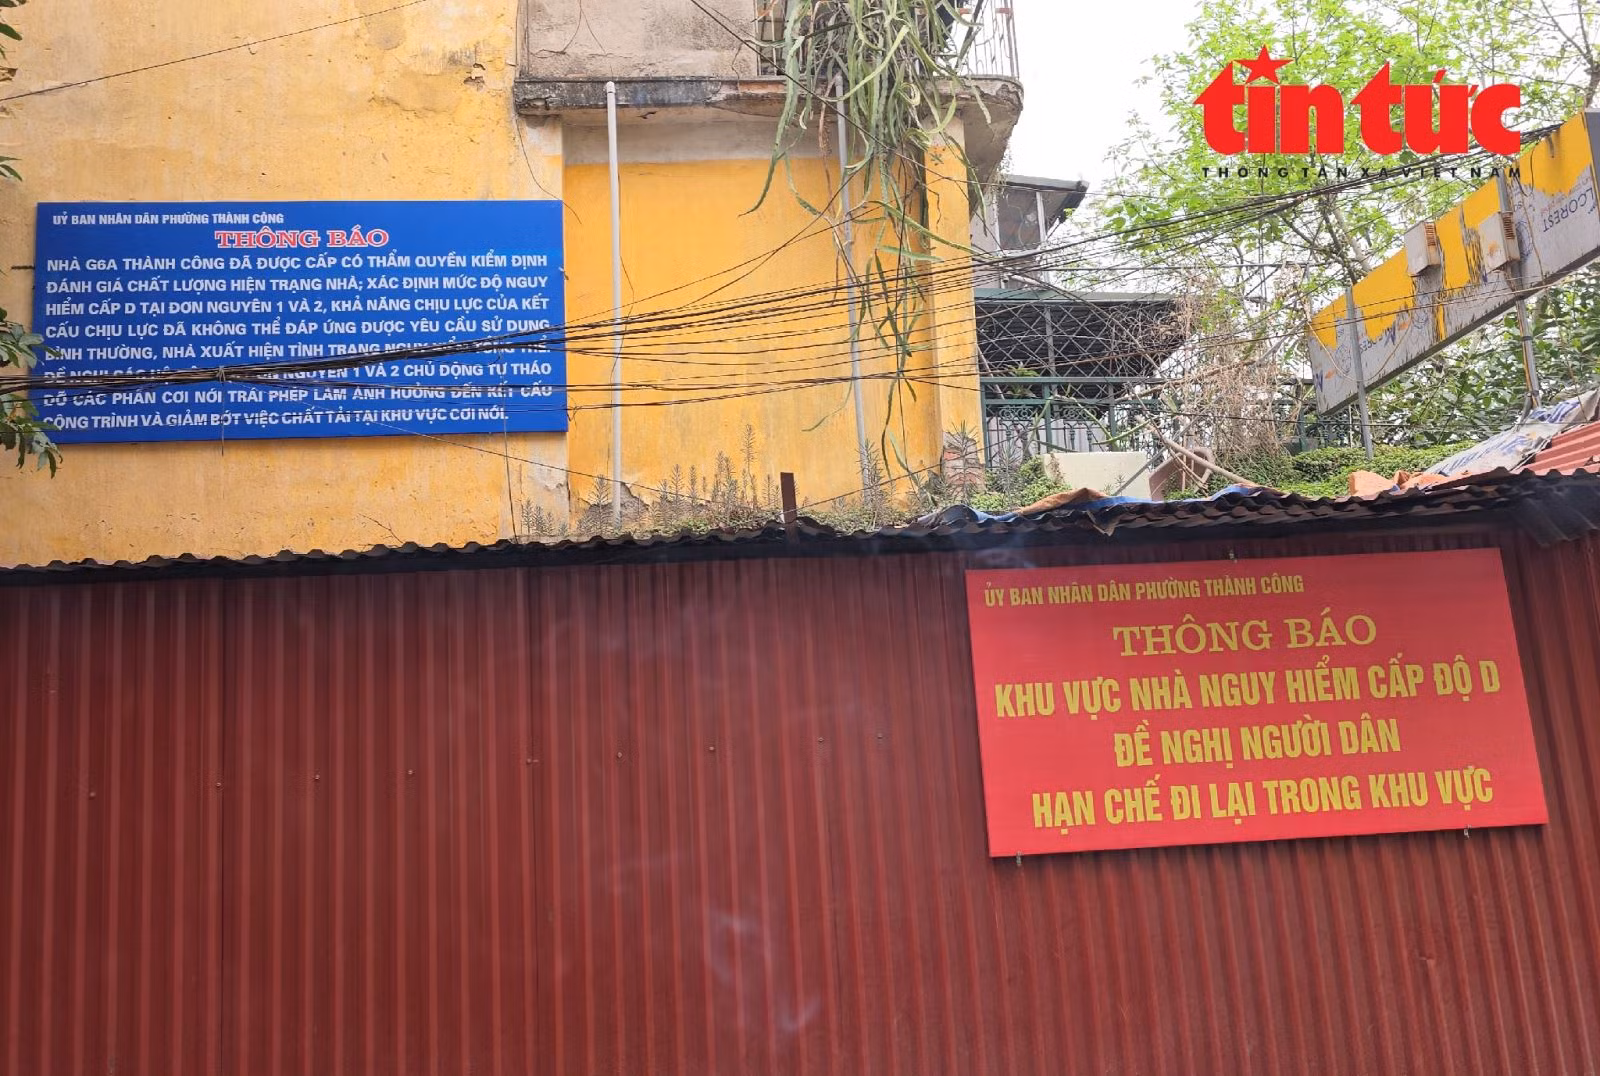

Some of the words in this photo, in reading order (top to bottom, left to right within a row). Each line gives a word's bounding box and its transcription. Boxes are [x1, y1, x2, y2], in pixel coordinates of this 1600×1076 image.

[71, 214, 96, 225] BAN
[99, 212, 132, 225] NHÂN
[134, 212, 159, 225] DÂN
[214, 225, 320, 249] THÔNG
[327, 224, 390, 248] BÁO
[47, 256, 81, 271] NHÀ
[85, 258, 118, 271] G6A
[122, 255, 176, 271] THÀNH
[180, 255, 225, 270] CÔNG
[229, 255, 252, 269] ĐÃ
[256, 256, 301, 272] ĐƯỢC
[305, 251, 337, 269] CẤP
[341, 253, 363, 268] CÓ
[367, 248, 411, 268] THẨM
[415, 250, 467, 268] QUYỀN
[471, 248, 507, 267] KIỂM
[511, 254, 547, 271] ĐỊNH
[46, 278, 92, 293] ĐÁNH
[96, 277, 124, 293] GIÁ
[127, 275, 169, 292] CHẤT
[173, 278, 226, 295] LƯỢNG
[230, 276, 266, 295] HIỆN
[270, 278, 322, 294] TRẠNG
[326, 275, 363, 292] NHÀ;
[366, 275, 399, 290] XÁC
[402, 277, 439, 292] ĐỊNH
[443, 274, 477, 289] MỨC
[480, 274, 502, 292] ĐỘ
[506, 276, 548, 288] NGUY
[45, 296, 84, 316] HIỂM
[88, 298, 121, 315] CẤP
[125, 303, 136, 314] D
[139, 302, 165, 317] TẠI
[168, 301, 203, 314] ĐƠN
[207, 298, 272, 313] NGUYÊN
[276, 301, 284, 312] 1
[288, 298, 310, 312] VÀ
[313, 301, 327, 314] 2,
[331, 295, 363, 312] KHẢ
[366, 297, 410, 311] NĂNG
[414, 298, 450, 314] CHỊU
[454, 297, 483, 314] LỰC
[486, 294, 519, 310] CỦA
[521, 292, 550, 310] KẾT
[45, 321, 79, 338] CẤU
[84, 324, 122, 341] CHỊU
[127, 323, 159, 340] LỰC
[163, 321, 186, 336] ĐÃ
[191, 320, 247, 336] KHÔNG
[252, 316, 280, 335] THỂ
[285, 319, 318, 335] ĐÁP
[323, 318, 357, 334] ỨNG
[361, 319, 405, 336] ĐƯỢC
[410, 317, 440, 333] YÊU
[444, 315, 477, 332] CẦU
[481, 315, 503, 332] SỬ
[86, 343, 157, 360] THƯỜNG,
[162, 343, 196, 359] NHÀ
[200, 340, 244, 358] XUẤT
[248, 342, 284, 361] HIỆN
[288, 342, 324, 357] TÌNH
[365, 362, 387, 377] VÀ
[390, 365, 400, 377] 2
[403, 360, 435, 377] CHỦ
[439, 362, 483, 379] ĐỘNG
[511, 360, 552, 375] THÁO
[161, 391, 189, 404] CƠI
[194, 388, 222, 404] NỚI
[91, 412, 138, 429] TRÌNH
[140, 411, 163, 427] VÀ
[165, 409, 207, 427] GIẢM
[210, 410, 242, 426] BỚT
[244, 410, 280, 428] VIỆC
[281, 406, 321, 425] CHẤT
[381, 409, 413, 422] KHU
[415, 408, 448, 424] VỰC
[449, 407, 476, 420] CƠI
[1009, 585, 1045, 607] BAN
[1048, 581, 1094, 604] NHÂN
[1097, 579, 1132, 602] DÂN
[1135, 575, 1200, 601] PHƯỜNG
[1204, 573, 1257, 598] THÀNH
[1260, 573, 1305, 595] CÔNG
[1113, 612, 1273, 657] THÔNG
[1286, 606, 1377, 650] BÁO
[995, 681, 1055, 718] KHU
[1063, 675, 1122, 721] VỰC
[1130, 668, 1193, 711] NHÀ
[1199, 672, 1277, 708] NGUY
[1285, 654, 1360, 704] HIỂM
[1368, 652, 1425, 699] CẤP
[1433, 653, 1474, 702] ĐỘ
[1481, 659, 1501, 694] D
[1114, 718, 1154, 768] ĐỀ
[1161, 726, 1234, 769] NGHỊ
[1241, 713, 1333, 761] NGƯỜI
[1339, 712, 1401, 755] DÂN
[1031, 790, 1096, 835] HẠN
[1104, 773, 1164, 825] CHẾ
[1170, 784, 1201, 821] ĐI
[1209, 780, 1257, 825] LẠI
[1262, 776, 1362, 814] TRONG
[1370, 770, 1430, 808] KHU
[1434, 764, 1494, 811] VỰC
